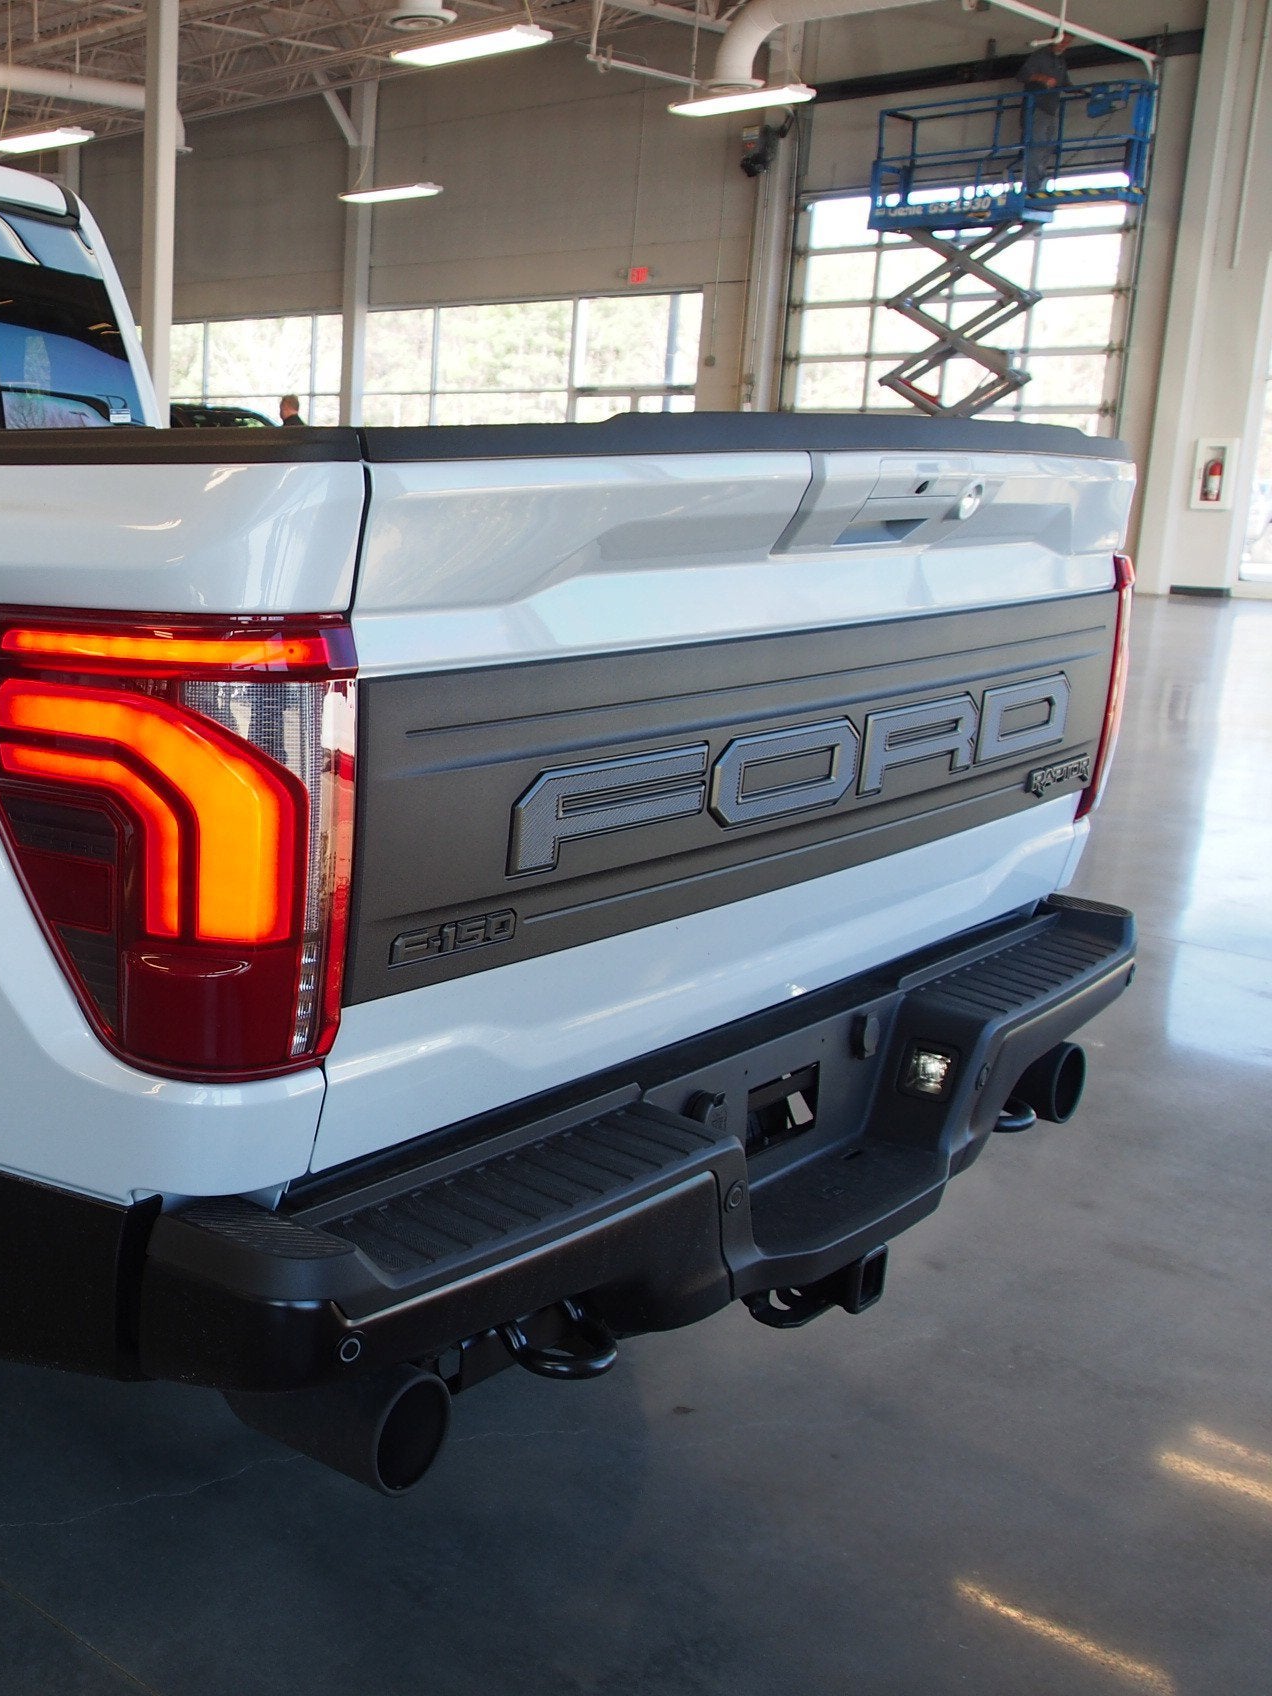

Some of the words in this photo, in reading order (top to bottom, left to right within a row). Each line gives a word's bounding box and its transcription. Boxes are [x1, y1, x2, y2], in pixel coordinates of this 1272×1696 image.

[928, 197, 991, 214] GS-1930
[507, 671, 1072, 878] FORD
[1026, 753, 1090, 797] RAPTOR
[388, 908, 517, 969] F-150
